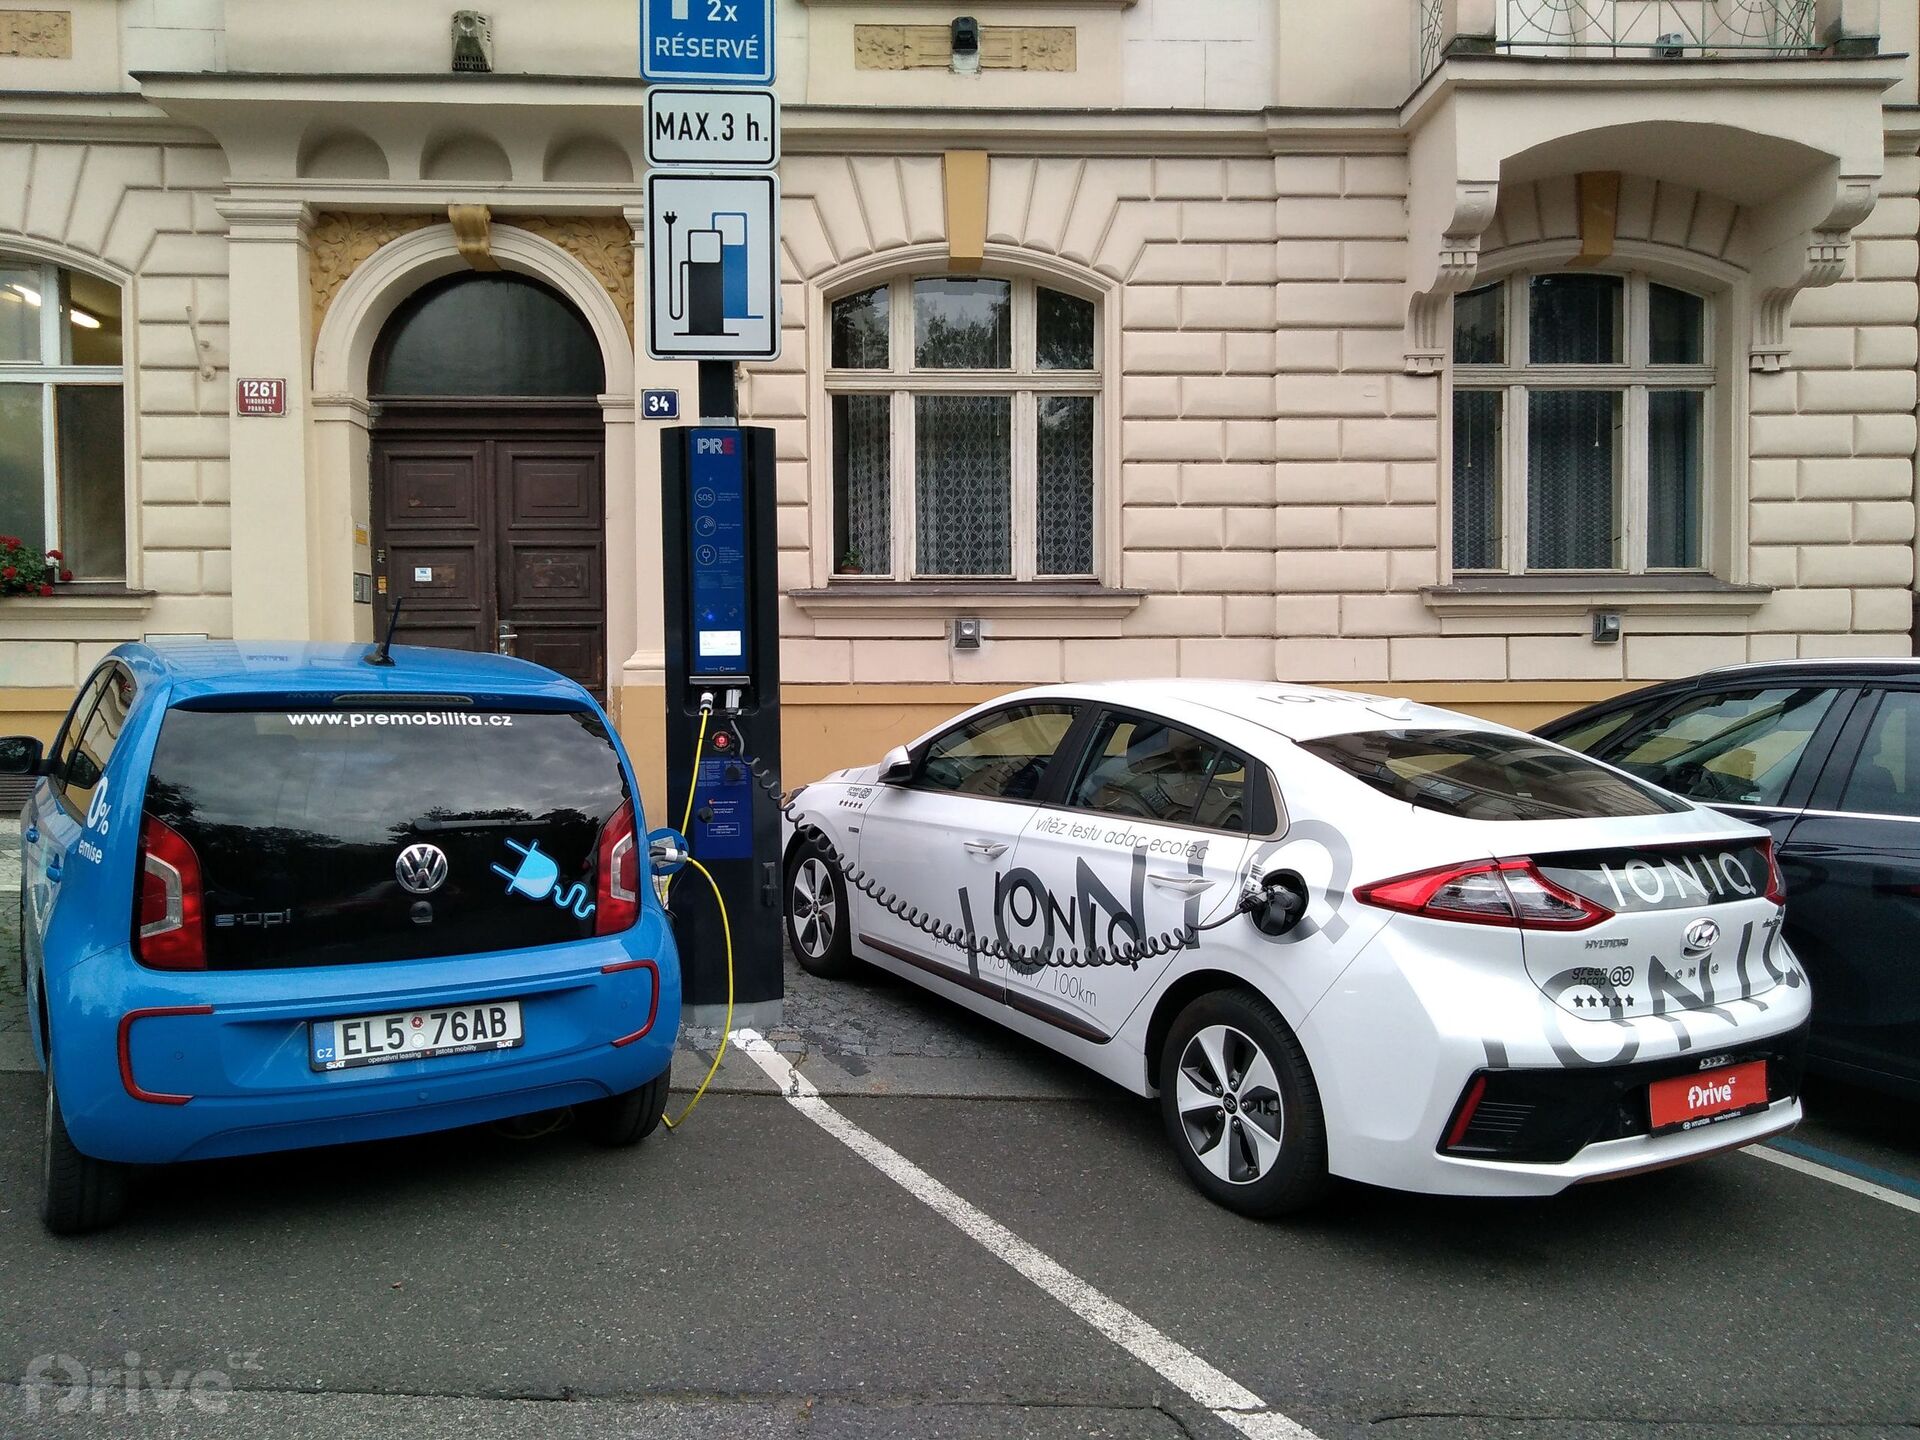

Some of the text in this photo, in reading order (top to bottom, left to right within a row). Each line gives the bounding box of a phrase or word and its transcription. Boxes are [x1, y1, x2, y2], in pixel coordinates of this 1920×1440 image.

[707, 0, 738, 22] 2x
[655, 34, 759, 60] RÉSERVÉ
[243, 381, 277, 397] 1261
[649, 395, 669, 411] 34
[697, 493, 713, 502] SOS
[287, 712, 513, 728] www.premobilita.cz
[87, 776, 112, 835] 0%
[1036, 815, 1068, 835] vítěz
[1068, 821, 1102, 841] testu
[1104, 825, 1147, 849] adac
[78, 839, 103, 864] emise
[1600, 852, 1757, 907] IONIQ
[1585, 937, 1629, 950] HYUNDAI
[1572, 967, 1608, 982] green
[1579, 975, 1607, 989] ncap
[1053, 969, 1097, 1006] 100km
[343, 1007, 507, 1056] EL5 76AB
[317, 1048, 333, 1059] CZ
